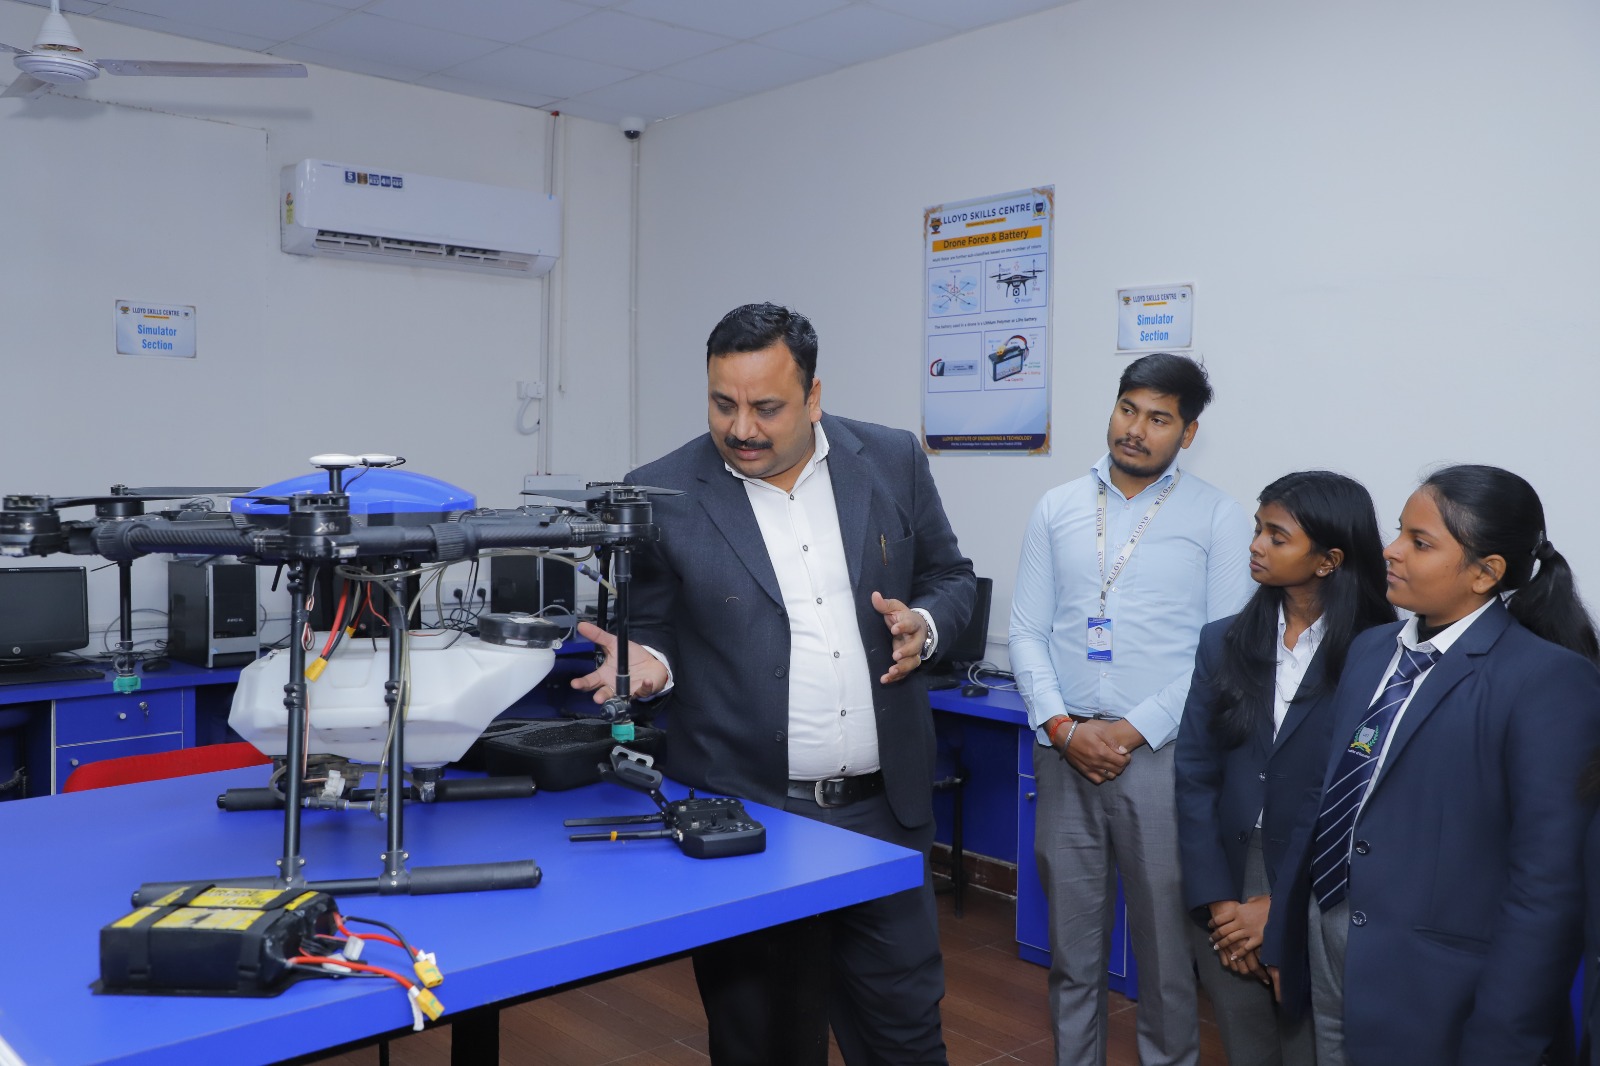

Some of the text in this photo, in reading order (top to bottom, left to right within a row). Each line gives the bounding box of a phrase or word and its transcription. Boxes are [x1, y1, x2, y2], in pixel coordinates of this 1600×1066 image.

[943, 213, 967, 224] LLOYD
[970, 208, 996, 220] SKILLS
[999, 203, 1031, 215] CENTRE
[944, 230, 1029, 248] Drone Force & Battery
[1137, 313, 1174, 326] Simulator
[138, 324, 177, 336] Simulator
[1140, 330, 1168, 341] Section
[142, 339, 173, 350] Section
[1133, 516, 1148, 539] LLOYD
[1109, 555, 1125, 580] LLOYD
